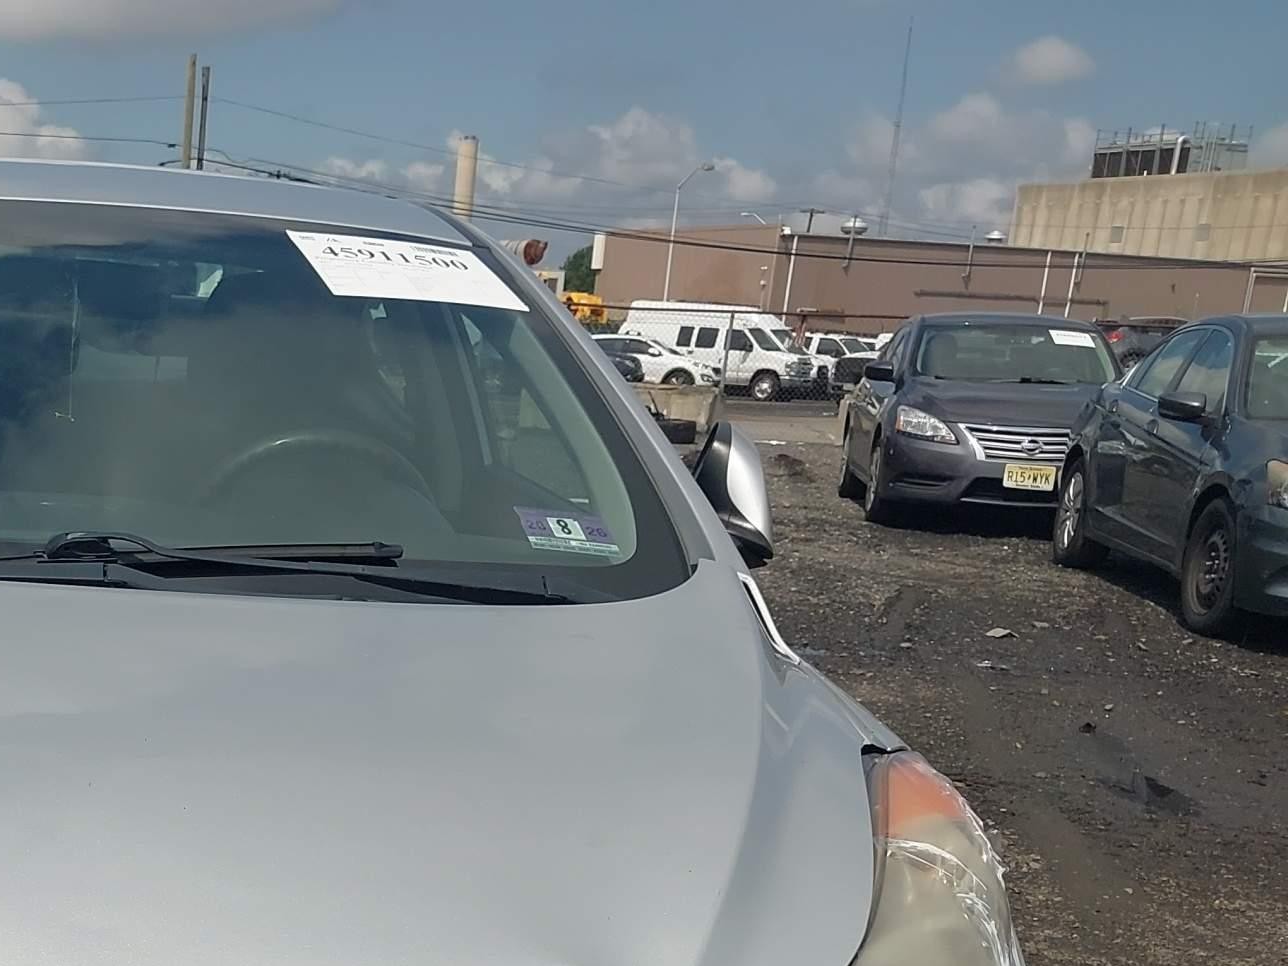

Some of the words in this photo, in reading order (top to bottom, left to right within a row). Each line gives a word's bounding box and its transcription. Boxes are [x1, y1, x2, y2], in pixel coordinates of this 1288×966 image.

[322, 245, 469, 271] 45911500
[527, 520, 547, 531] 20
[556, 519, 572, 535] 8
[585, 526, 608, 538] 26
